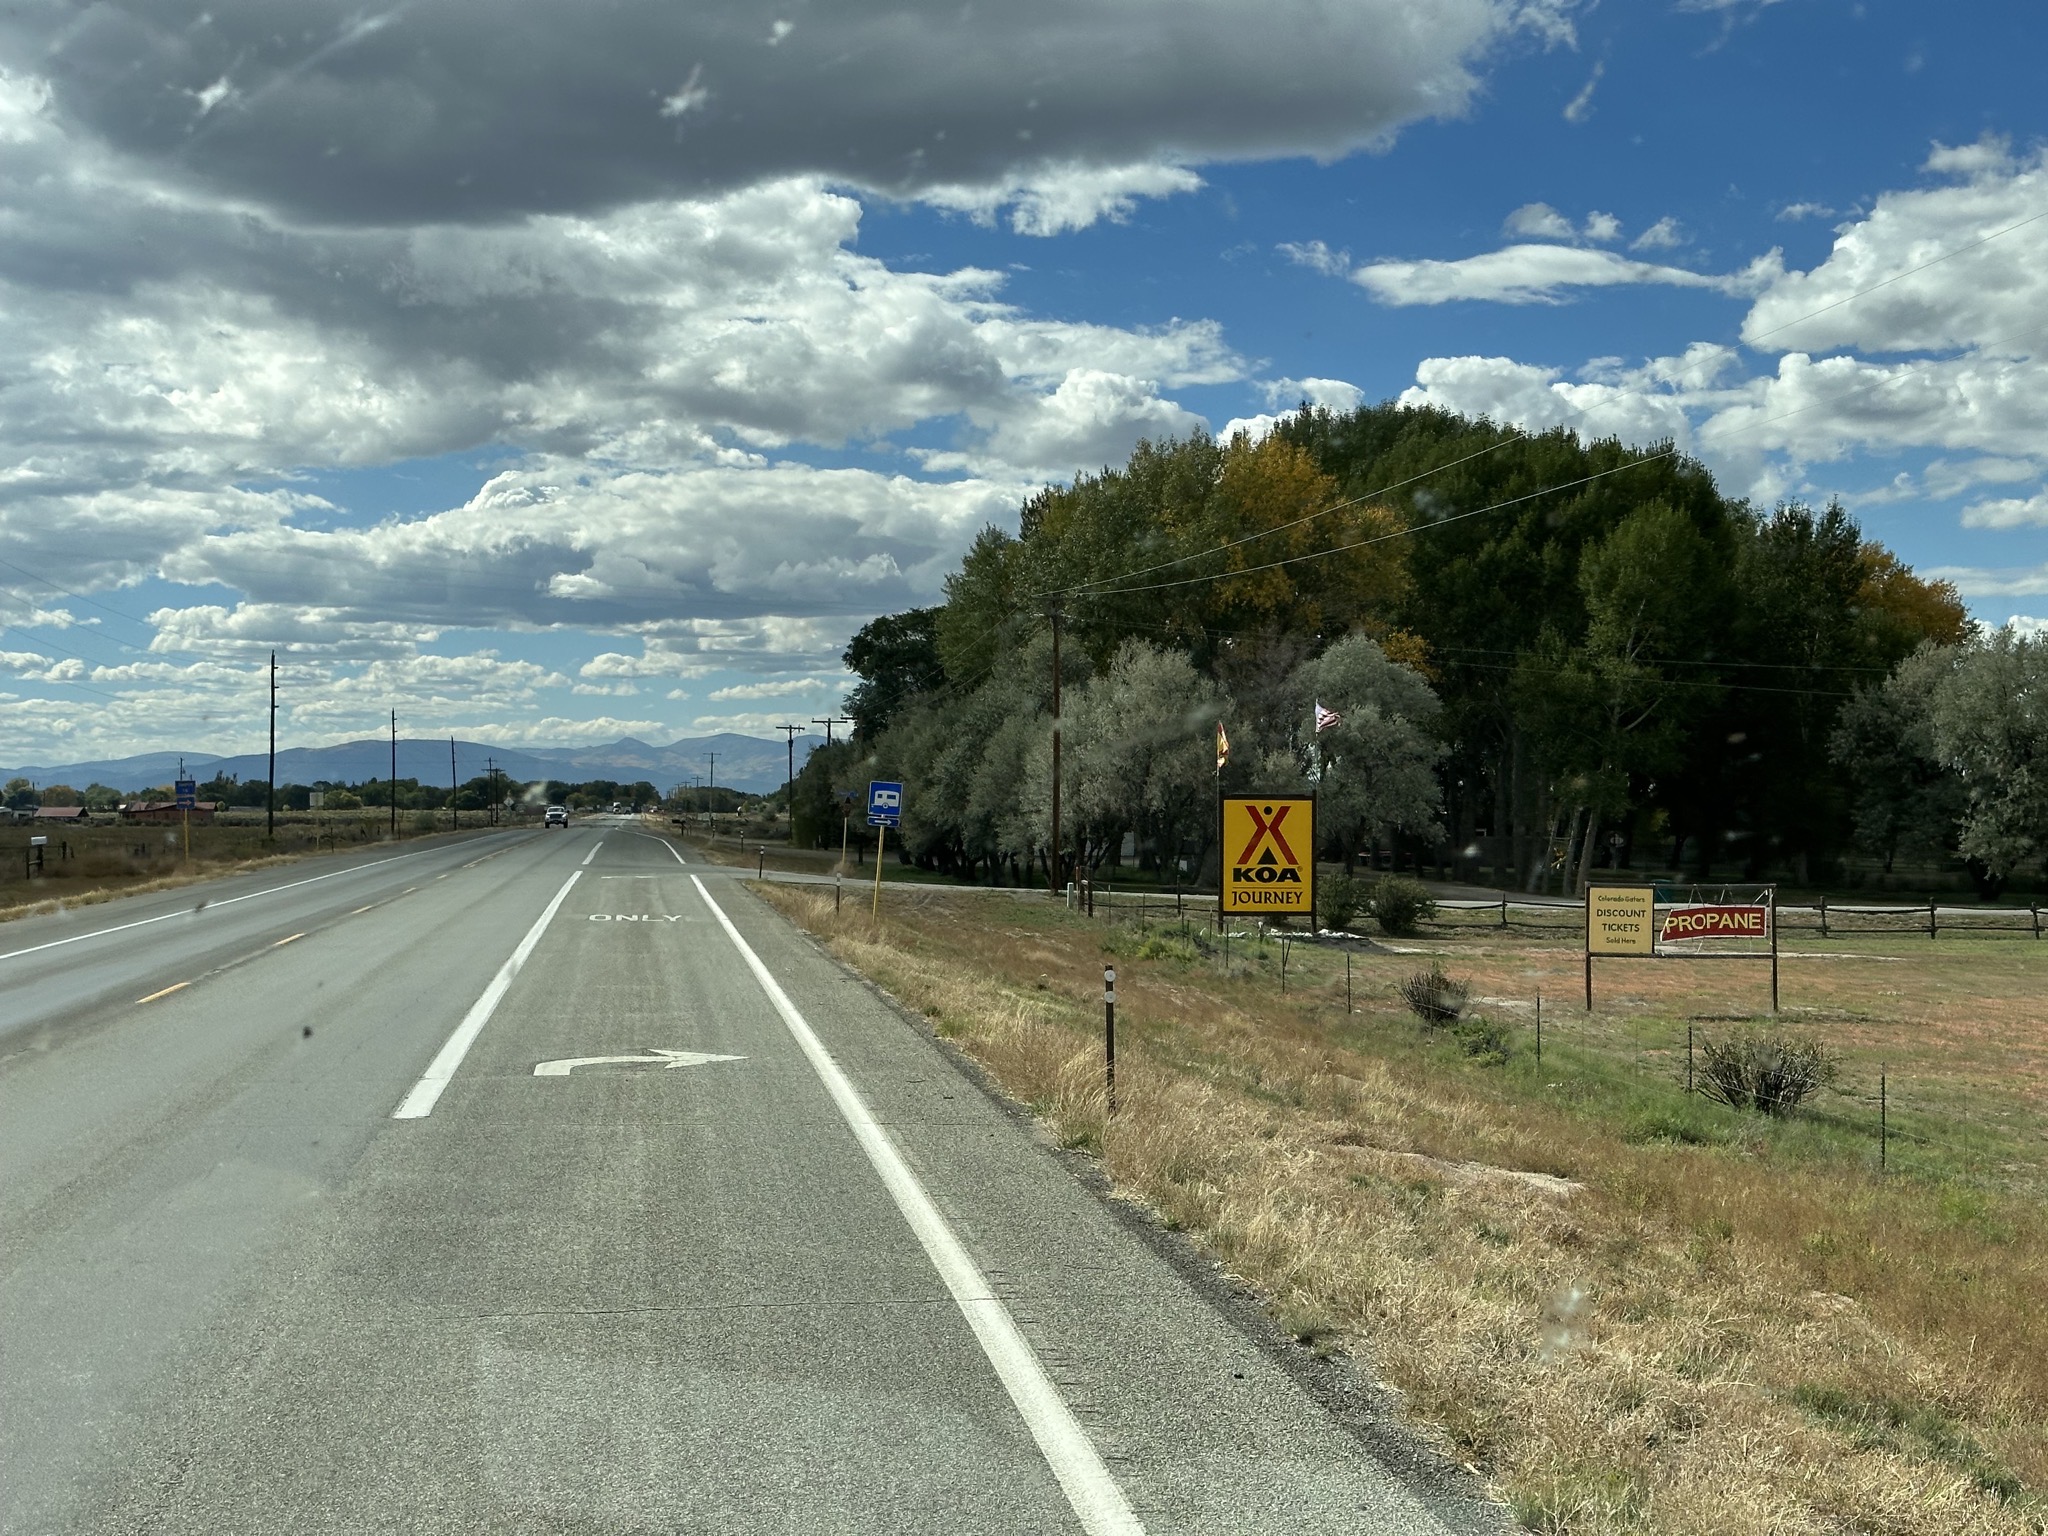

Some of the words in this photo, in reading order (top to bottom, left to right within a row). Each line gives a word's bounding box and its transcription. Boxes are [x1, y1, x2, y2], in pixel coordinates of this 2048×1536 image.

[1232, 866, 1302, 883] KOA
[1231, 891, 1303, 906] JOURNEY
[1597, 895, 1624, 903] Colorado
[588, 914, 683, 922] ONLY
[1596, 908, 1647, 918] DISCOUNT
[1601, 922, 1640, 933] TICKETS
[1664, 913, 1762, 934] PROPANE
[1605, 936, 1620, 945] Sold
[1621, 937, 1637, 945] Here
